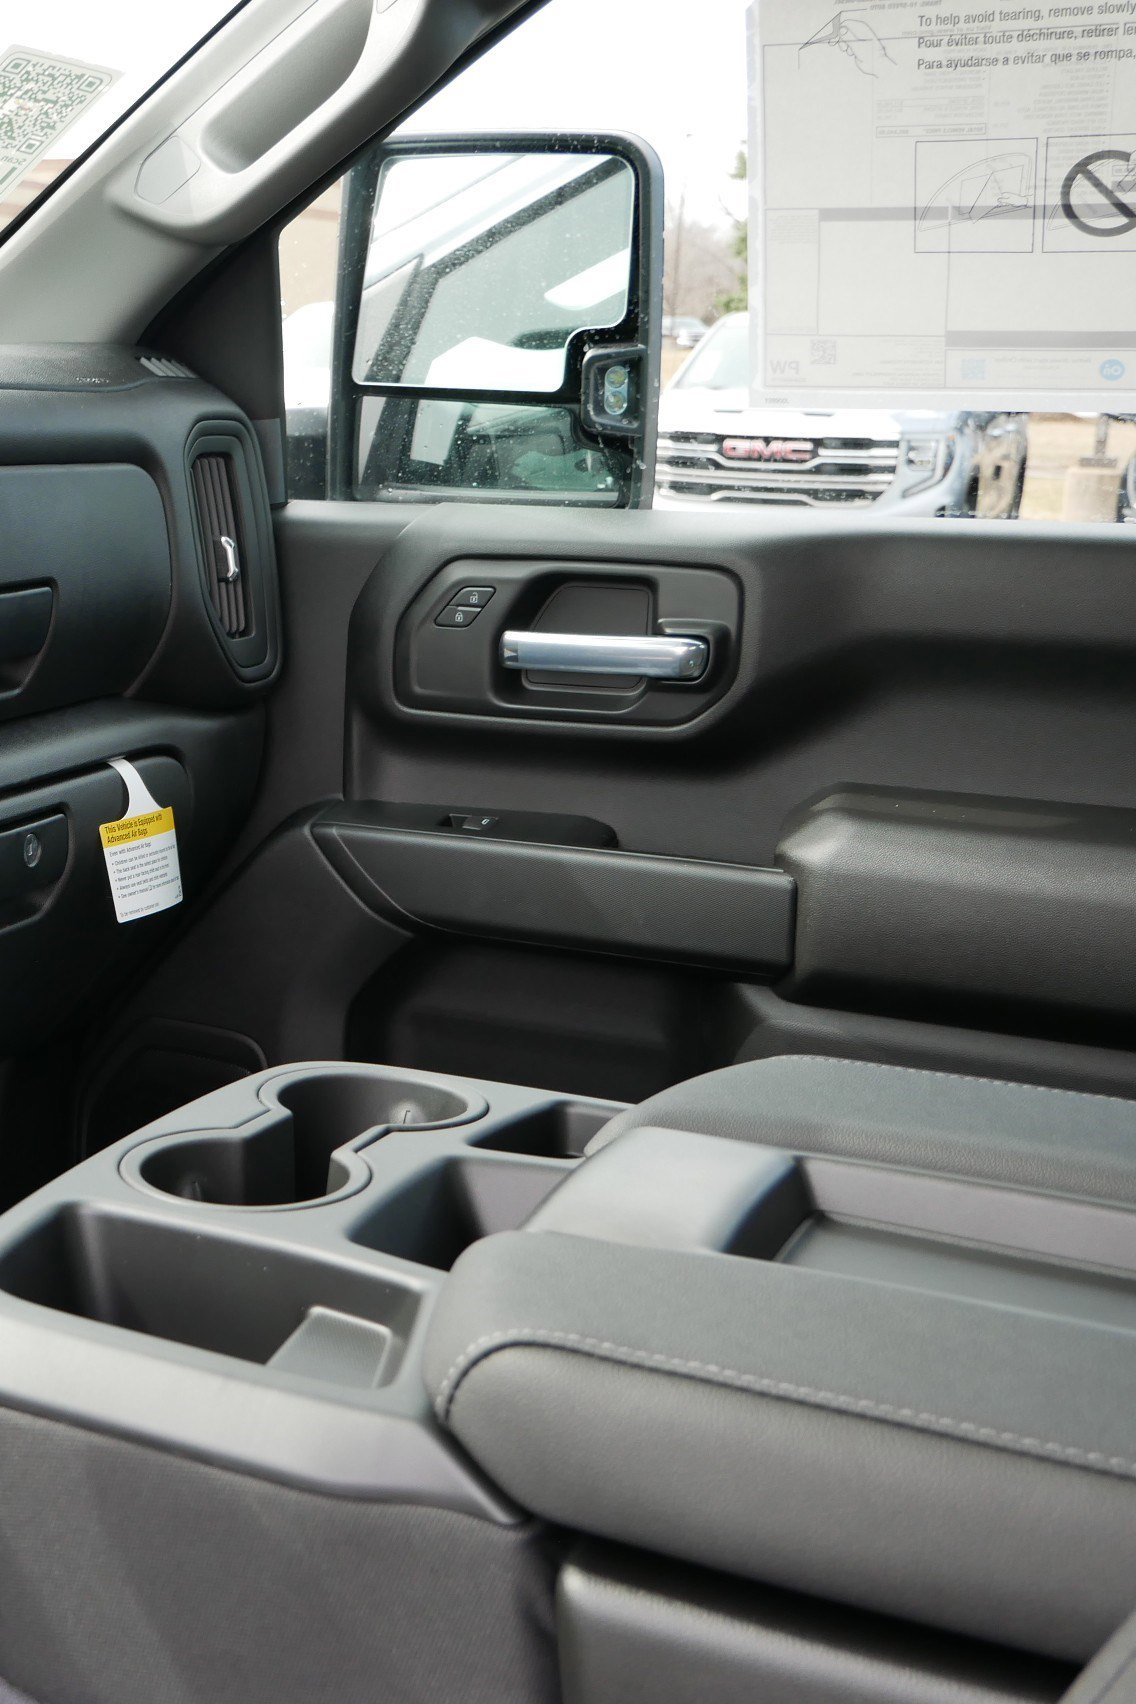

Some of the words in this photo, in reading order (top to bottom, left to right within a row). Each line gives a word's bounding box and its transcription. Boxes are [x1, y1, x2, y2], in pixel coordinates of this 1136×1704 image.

[918, 15, 932, 27] To
[935, 13, 960, 27] help
[964, 10, 995, 24] avoid
[999, 8, 1044, 22] tearing,
[1048, 5, 1093, 18] remove
[1097, 0, 1136, 15] slowly
[918, 36, 943, 49] Pour
[947, 33, 980, 47] éviter
[983, 32, 1013, 45] toute
[1017, 28, 1077, 43] déchirure,
[1081, 24, 1120, 38] retirer
[918, 58, 943, 70] Para
[946, 56, 999, 71] ayudarse
[1002, 56, 1009, 66] a
[1013, 52, 1047, 65] evitar
[1050, 52, 1072, 65] que
[1076, 50, 1090, 61] se
[1093, 48, 1136, 61] rompa,
[722, 437, 814, 460] GMC
[105, 825, 116, 834] This
[117, 820, 133, 831] Vehicle
[138, 815, 155, 826] Equipped
[106, 830, 130, 843] Advanced
